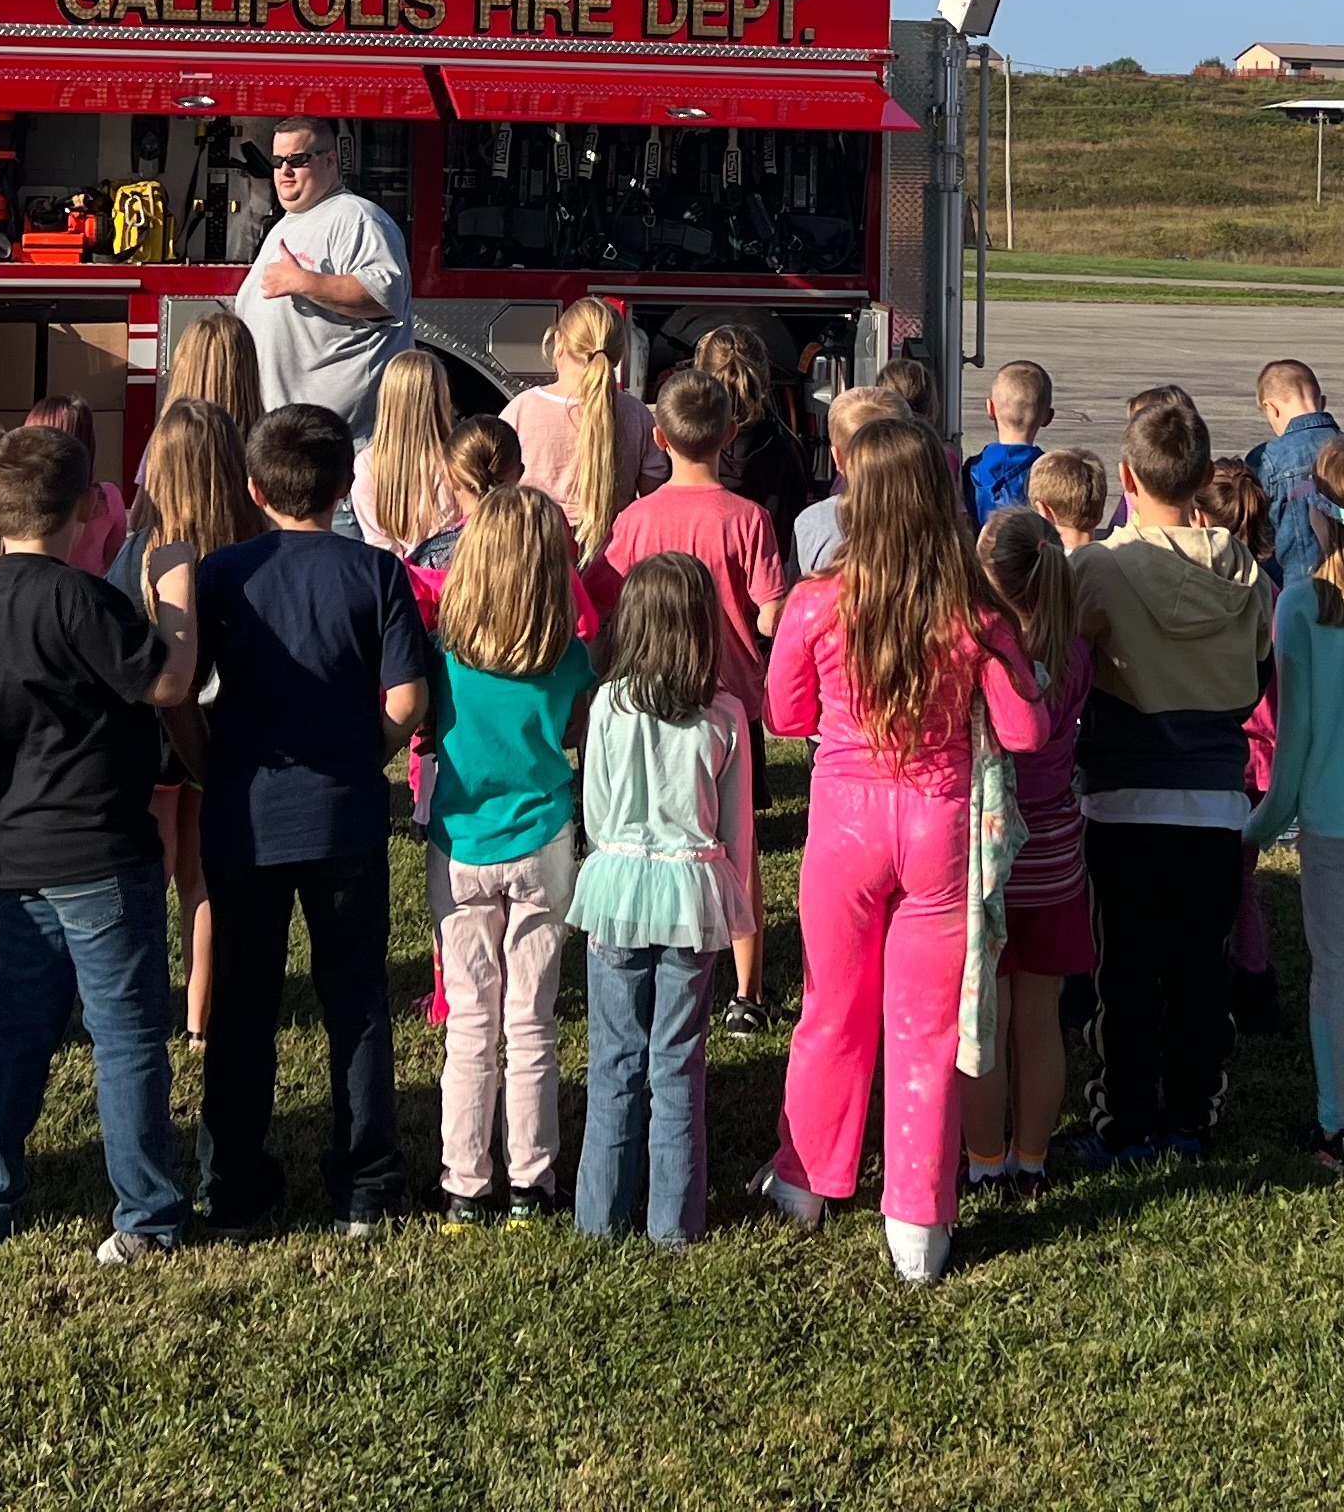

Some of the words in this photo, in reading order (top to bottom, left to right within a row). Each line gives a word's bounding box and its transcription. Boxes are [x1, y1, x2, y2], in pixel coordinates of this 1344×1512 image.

[341, 138, 352, 170] MSA
[494, 130, 508, 164] MSA
[559, 144, 570, 178] MSA
[648, 143, 659, 177] MSA
[727, 151, 738, 184] MSA
